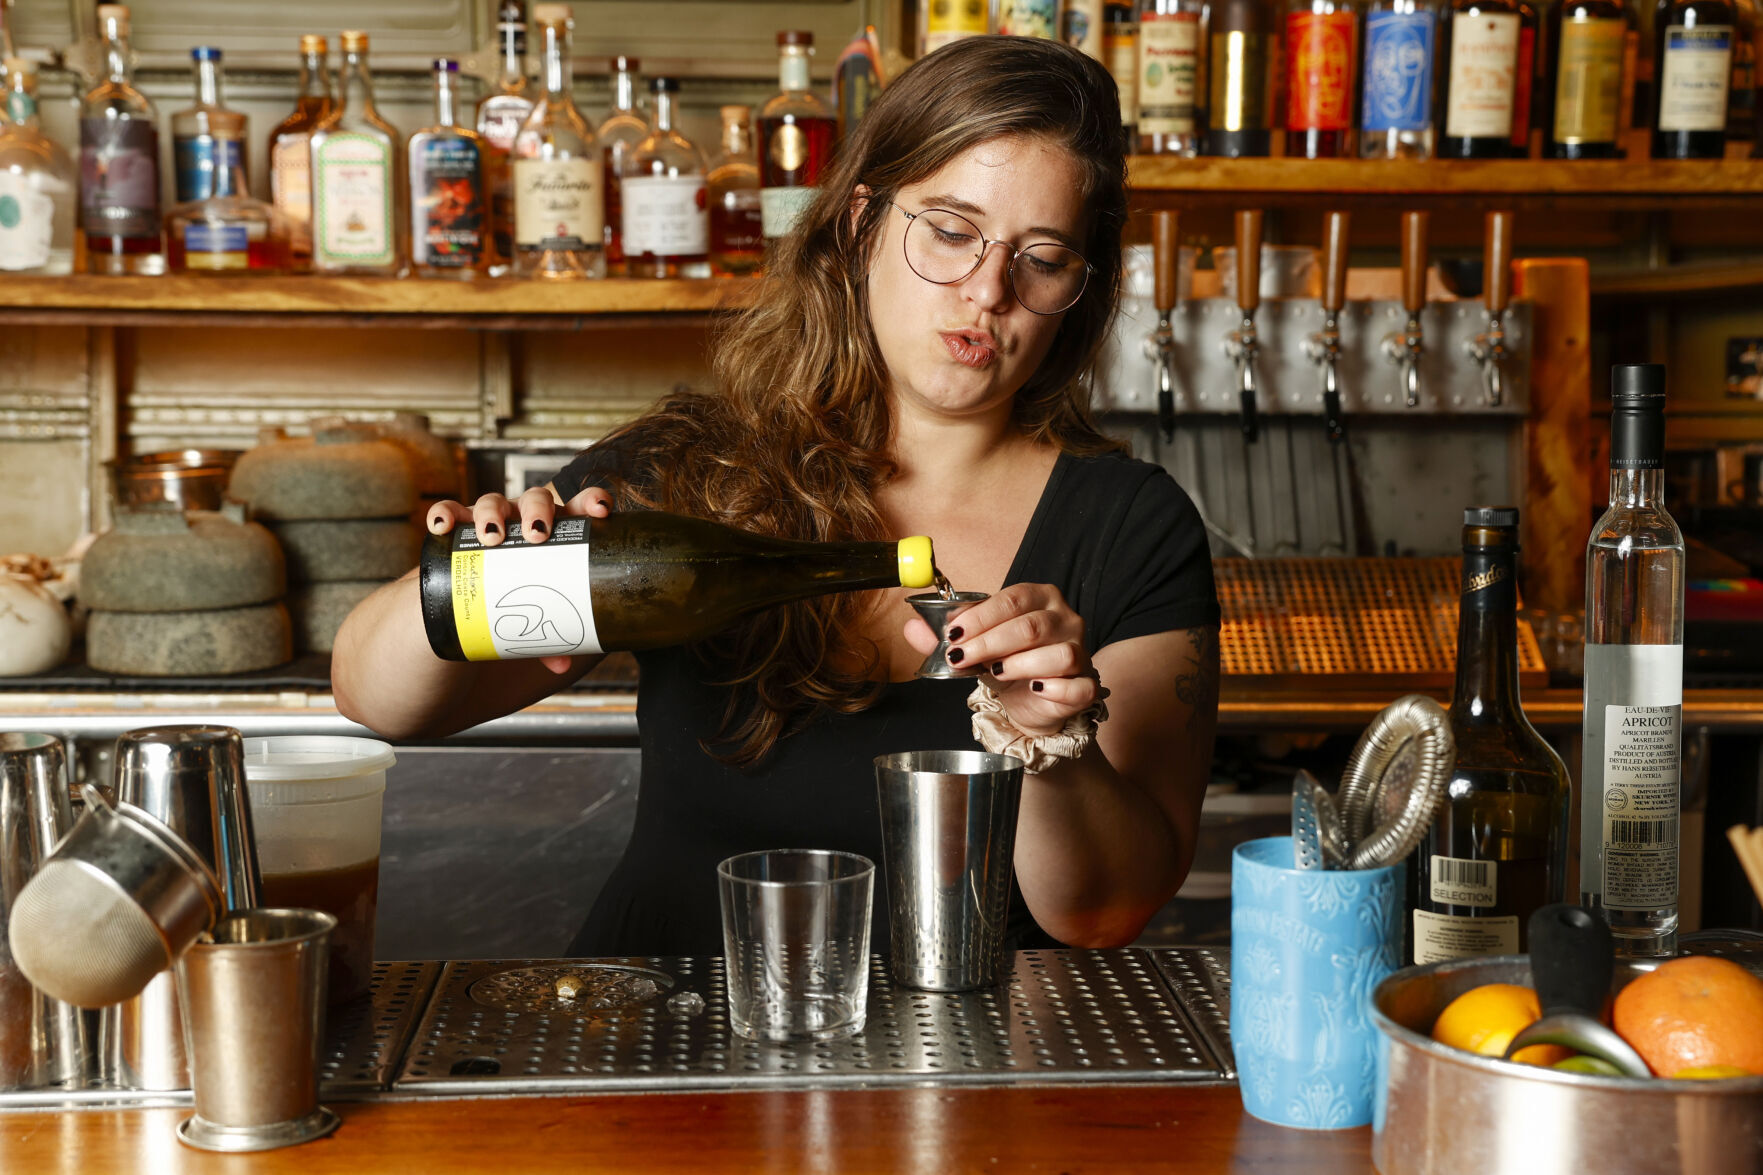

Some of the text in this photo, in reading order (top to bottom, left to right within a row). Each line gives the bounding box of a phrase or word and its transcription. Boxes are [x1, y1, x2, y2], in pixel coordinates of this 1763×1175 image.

[455, 555, 463, 596] VERDELHO
[1625, 706, 1671, 714] EAU-DE-VIE
[1622, 717, 1673, 727] APRICOT
[1614, 750, 1645, 758] PRODUCT
[1609, 757, 1643, 765] DISTILLED
[1432, 887, 1493, 903] SELECTION
[1270, 911, 1326, 952] ESTATE
